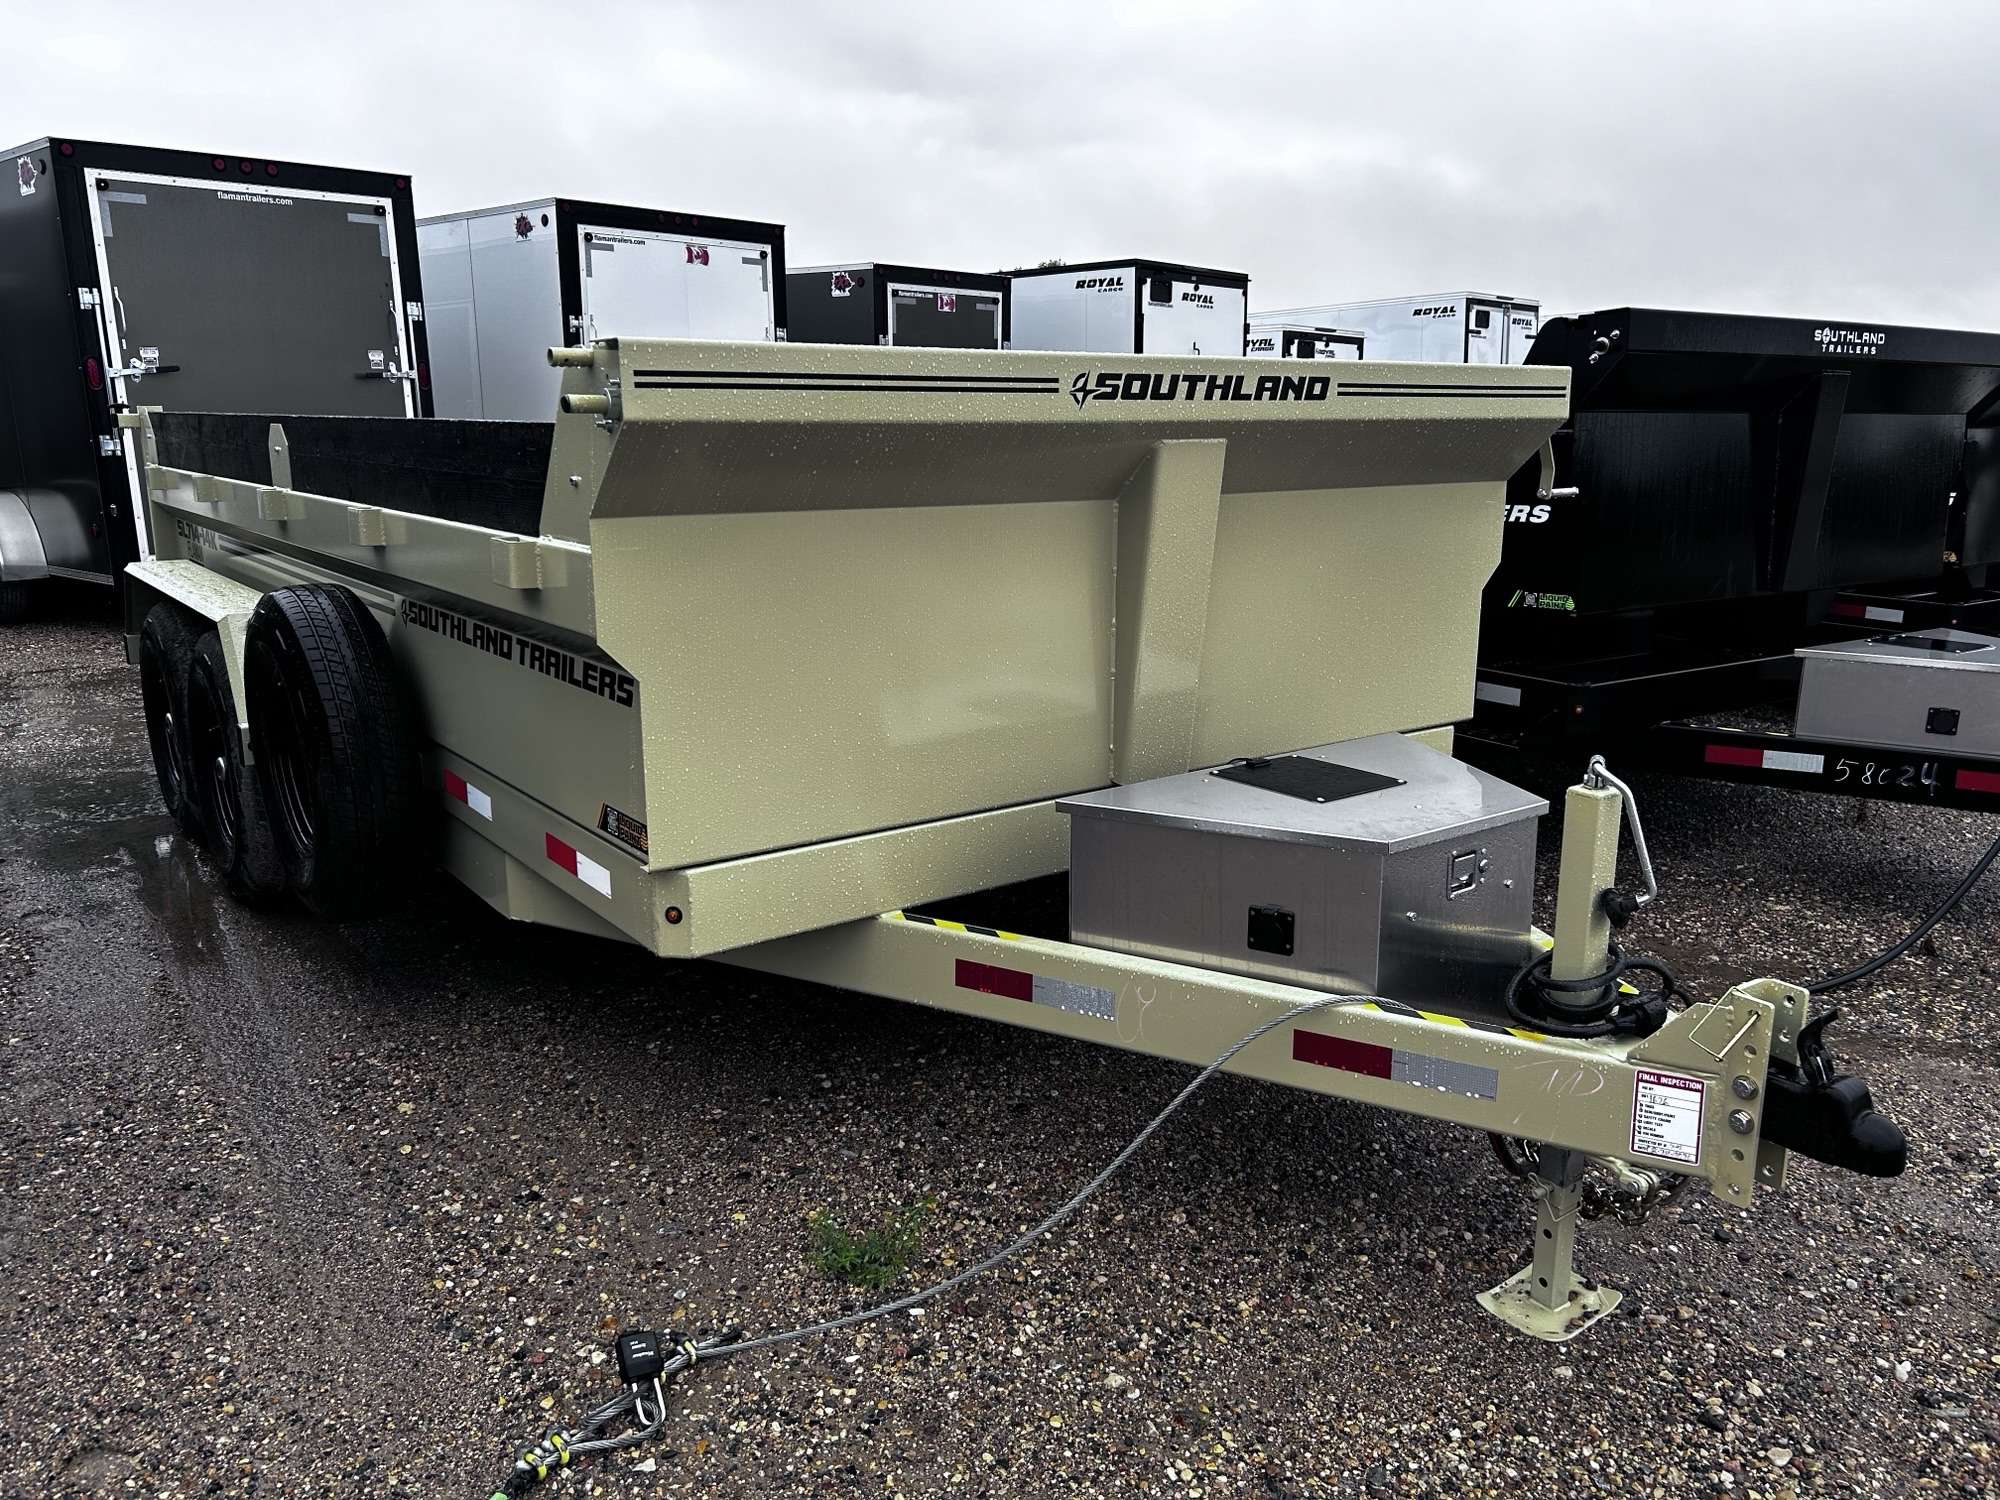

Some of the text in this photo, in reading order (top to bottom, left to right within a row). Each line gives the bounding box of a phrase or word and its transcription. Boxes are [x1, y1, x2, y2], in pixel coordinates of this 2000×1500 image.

[217, 191, 293, 205] flamantrailers.com
[1075, 276, 1124, 289] ROYAL
[1182, 292, 1214, 304] ROYAL
[1413, 305, 1457, 317] ROYAL
[1512, 318, 1533, 327] ROYAL
[1814, 327, 1886, 345] SOUTHLAND
[1822, 344, 1877, 355] TRAILERS
[1092, 372, 1331, 401] SOUTHLAND
[408, 599, 635, 708] SOUTHLAND TRAILERS
[1639, 1073, 1658, 1083] FINAL
[1660, 1076, 1703, 1090] INSPECTION
